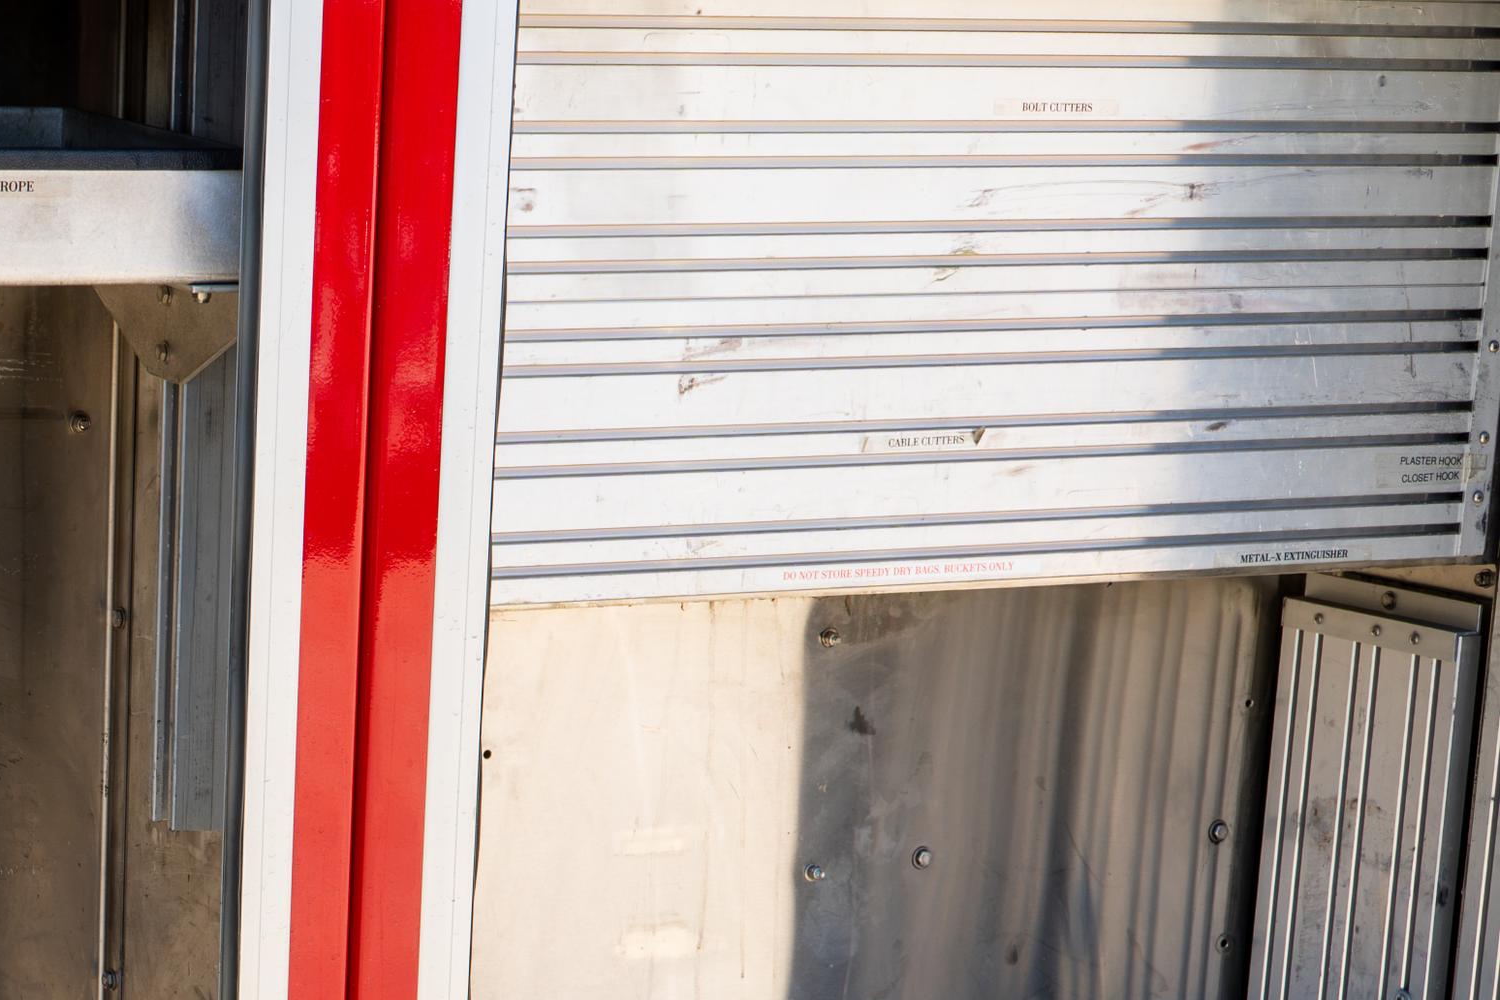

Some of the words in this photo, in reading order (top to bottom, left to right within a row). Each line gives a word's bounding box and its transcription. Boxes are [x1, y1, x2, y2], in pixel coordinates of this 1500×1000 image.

[1022, 102, 1047, 112] BOLT
[1049, 102, 1093, 112] CUTTERS
[0, 180, 35, 193] ROPE
[888, 437, 919, 448] CABLE
[921, 435, 965, 446] CUTTERS
[1400, 456, 1437, 466] PLASTER
[1438, 456, 1462, 466] HOOK
[1401, 473, 1434, 483] CLOSET
[1436, 471, 1460, 481] HOOK
[1240, 552, 1282, 564] METAL-X
[1283, 549, 1349, 561] EXTINGUISHER
[783, 571, 797, 581] DO
[799, 570, 819, 580] NOT
[821, 568, 853, 579] STORE
[854, 567, 891, 578] SPEEDY
[893, 566, 912, 576] DRY
[943, 562, 987, 574] BUCKETS
[988, 561, 1014, 572] ONLY
